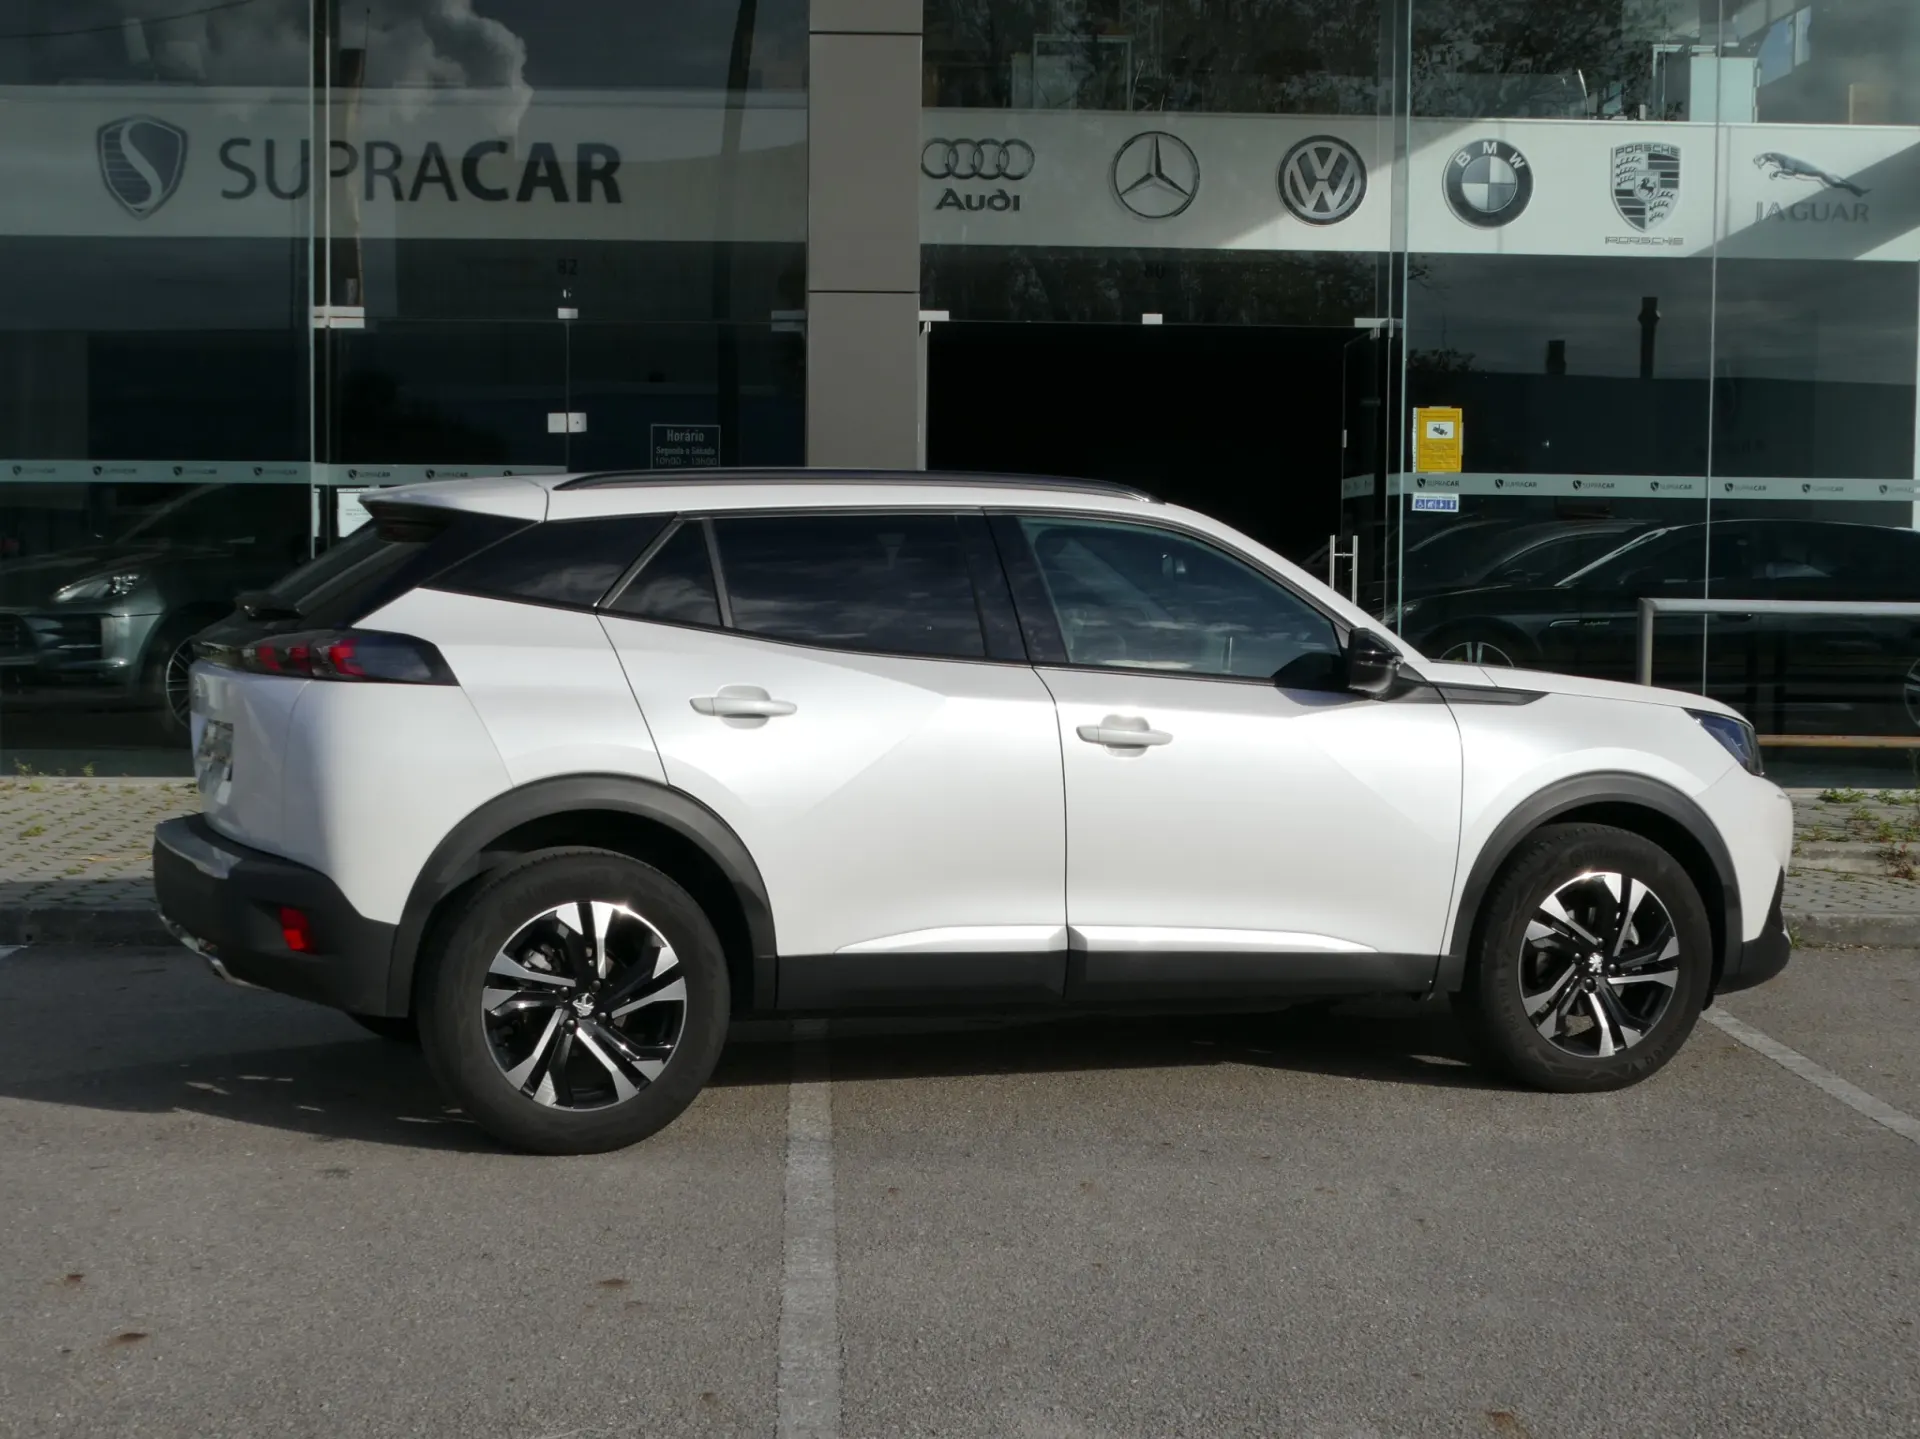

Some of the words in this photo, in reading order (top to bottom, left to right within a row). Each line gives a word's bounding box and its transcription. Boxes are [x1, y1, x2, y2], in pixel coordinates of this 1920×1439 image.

[1455, 141, 1526, 169] BMW
[1615, 143, 1681, 158] PORSCHE
[218, 138, 622, 204] SUPRACAR
[935, 187, 1020, 212] Audi
[1756, 201, 1869, 224] JAGUAR
[1605, 236, 1684, 246] PORSCHE
[667, 428, 704, 442] Horário
[1426, 480, 1460, 488] SUPRACAR
